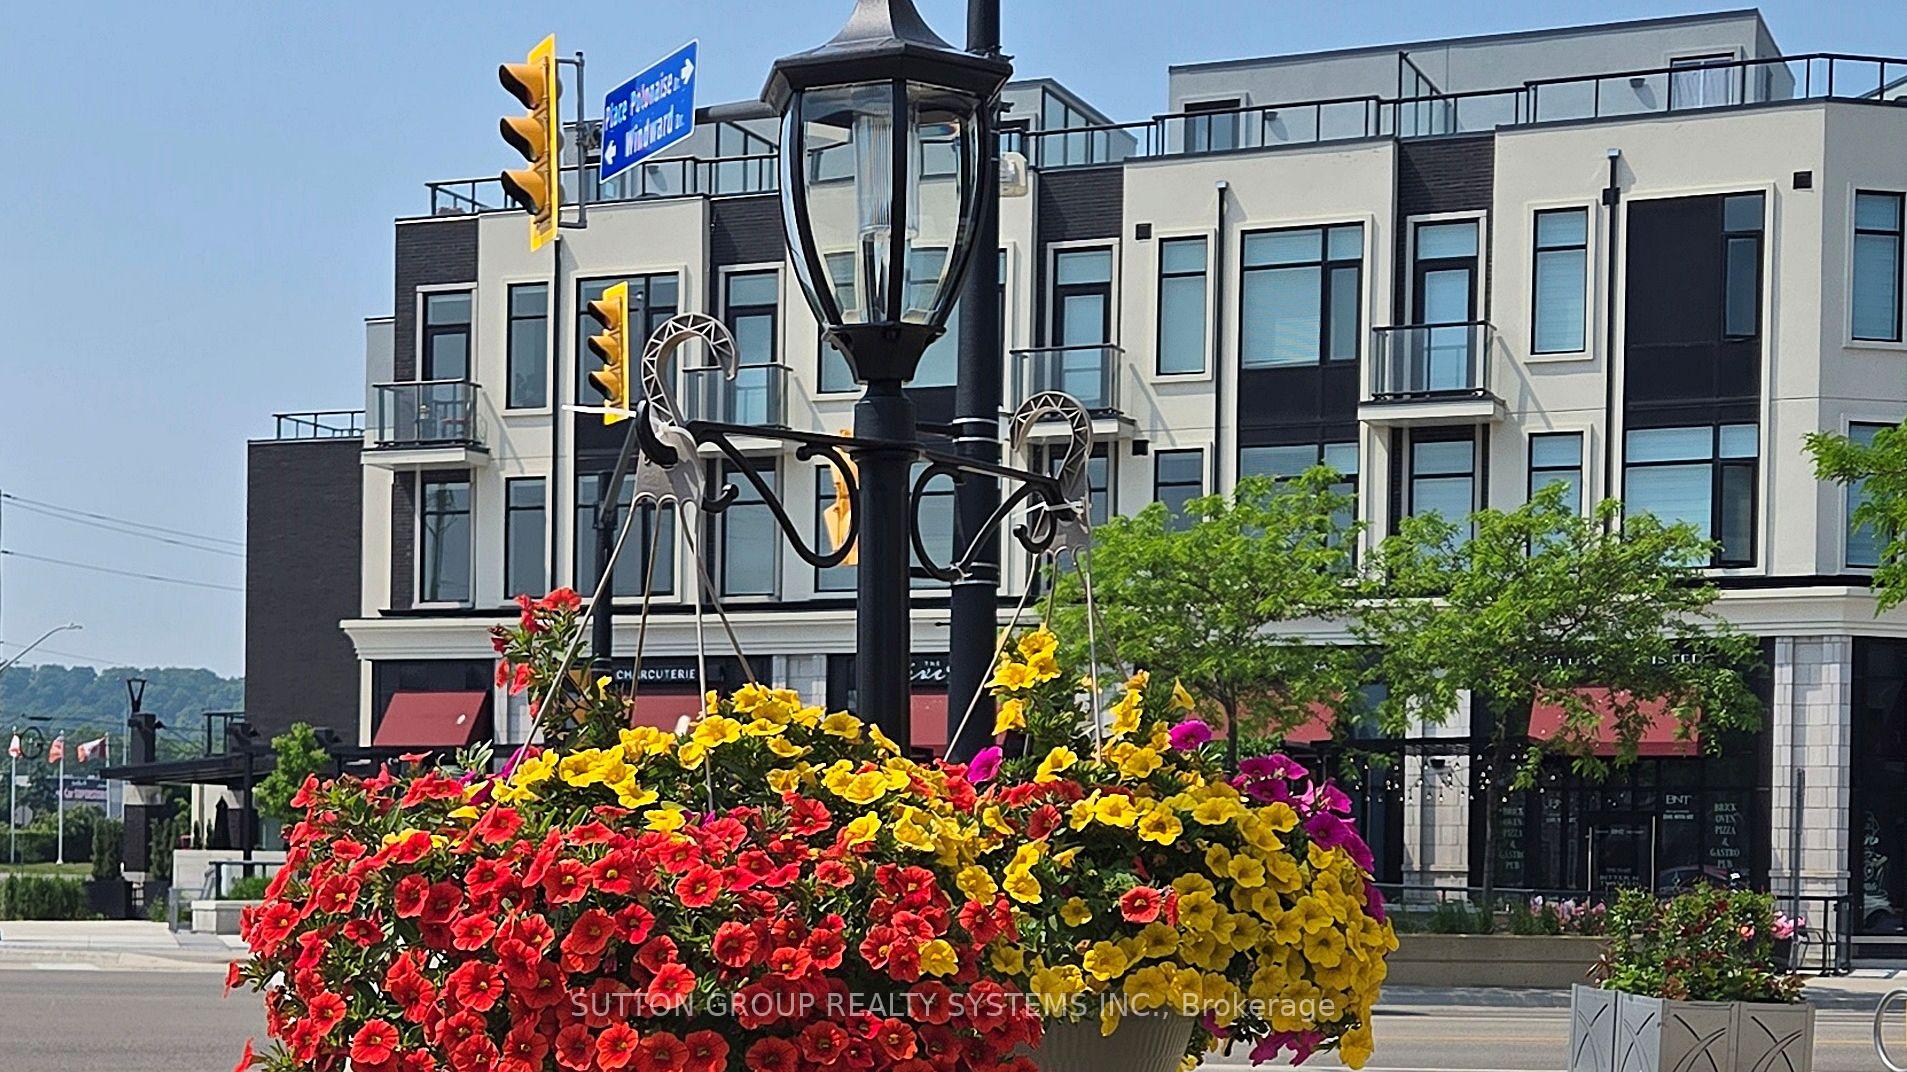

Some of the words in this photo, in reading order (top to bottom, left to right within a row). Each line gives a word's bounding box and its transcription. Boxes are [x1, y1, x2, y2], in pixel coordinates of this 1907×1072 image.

[605, 99, 628, 131] Place
[630, 72, 674, 117] Polonaise
[625, 103, 674, 157] Windward
[1715, 825, 1736, 835] PIZZA
[1710, 848, 1740, 857] GASTRO
